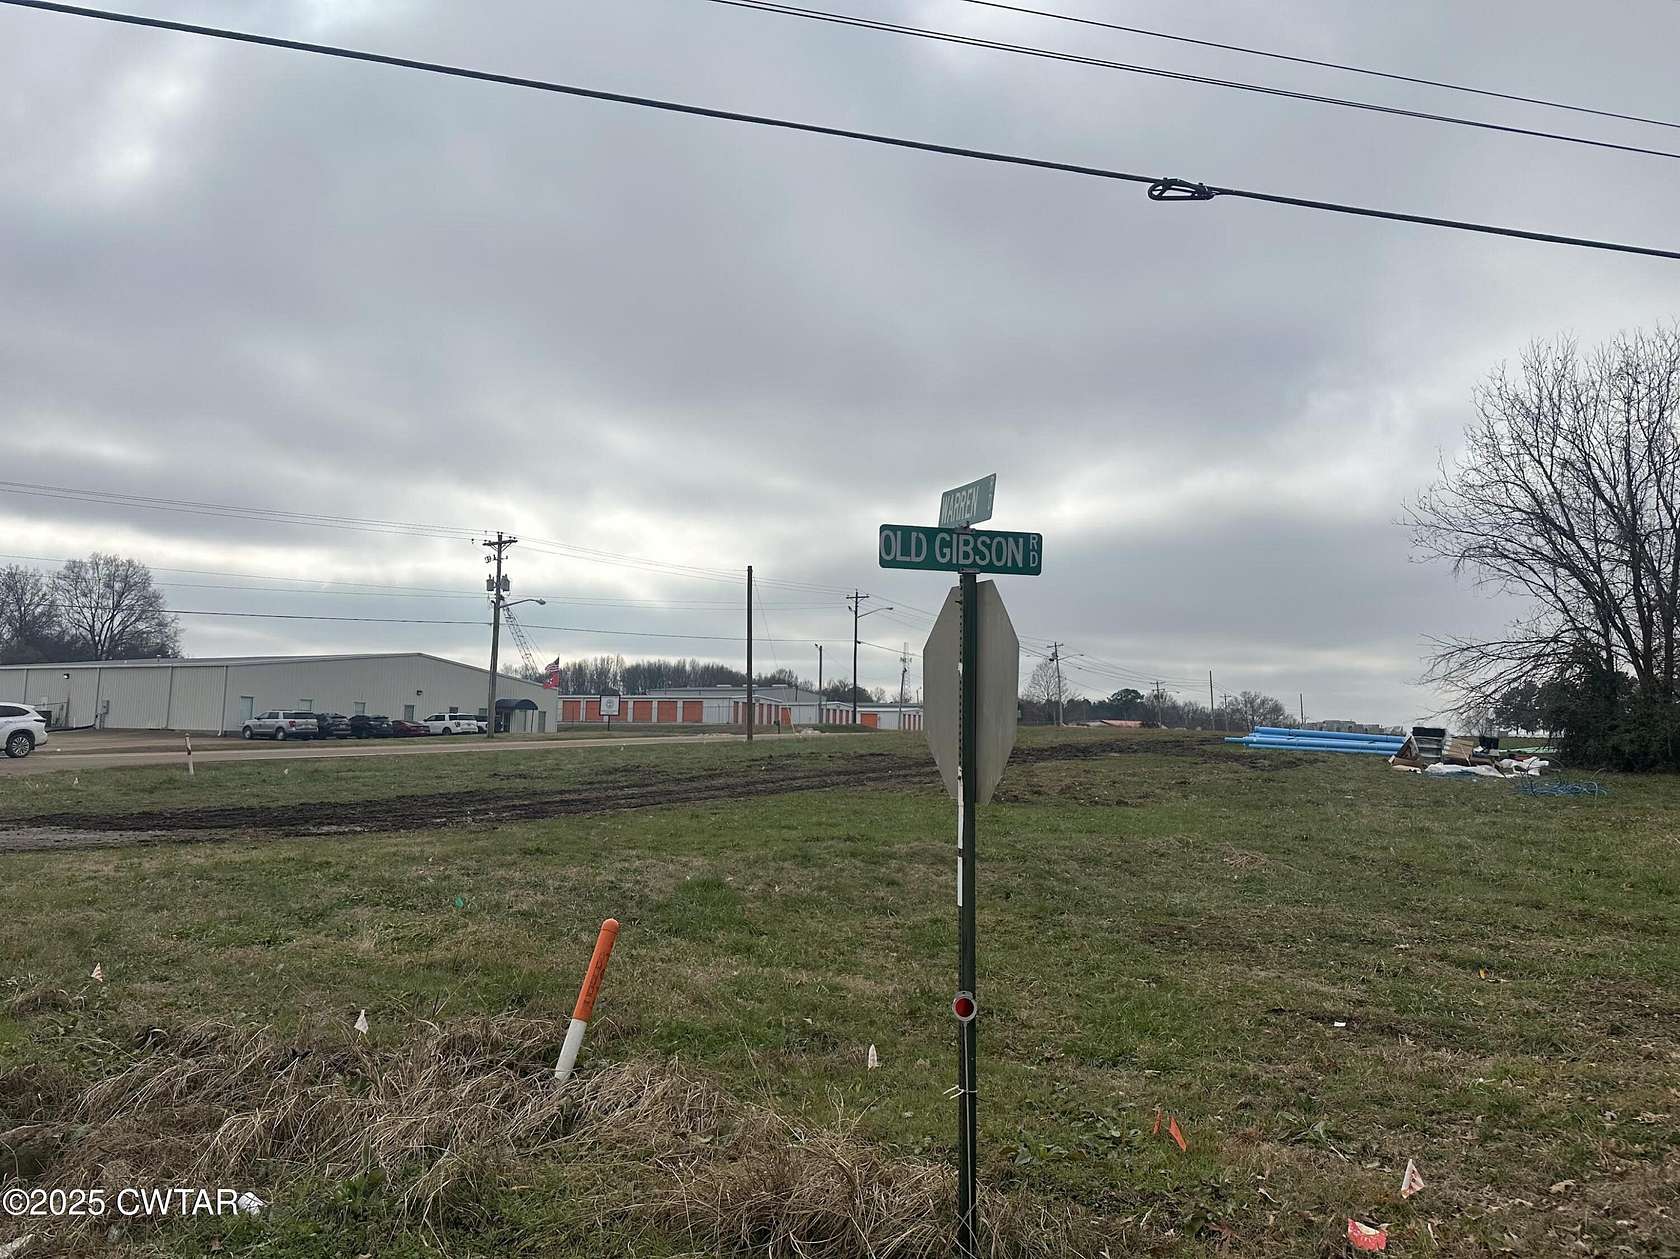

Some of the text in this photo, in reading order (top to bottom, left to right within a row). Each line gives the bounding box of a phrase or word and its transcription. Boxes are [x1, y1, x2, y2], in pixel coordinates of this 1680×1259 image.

[941, 486, 979, 523] WARREN
[880, 530, 1039, 568] OLD GIBSON RD
